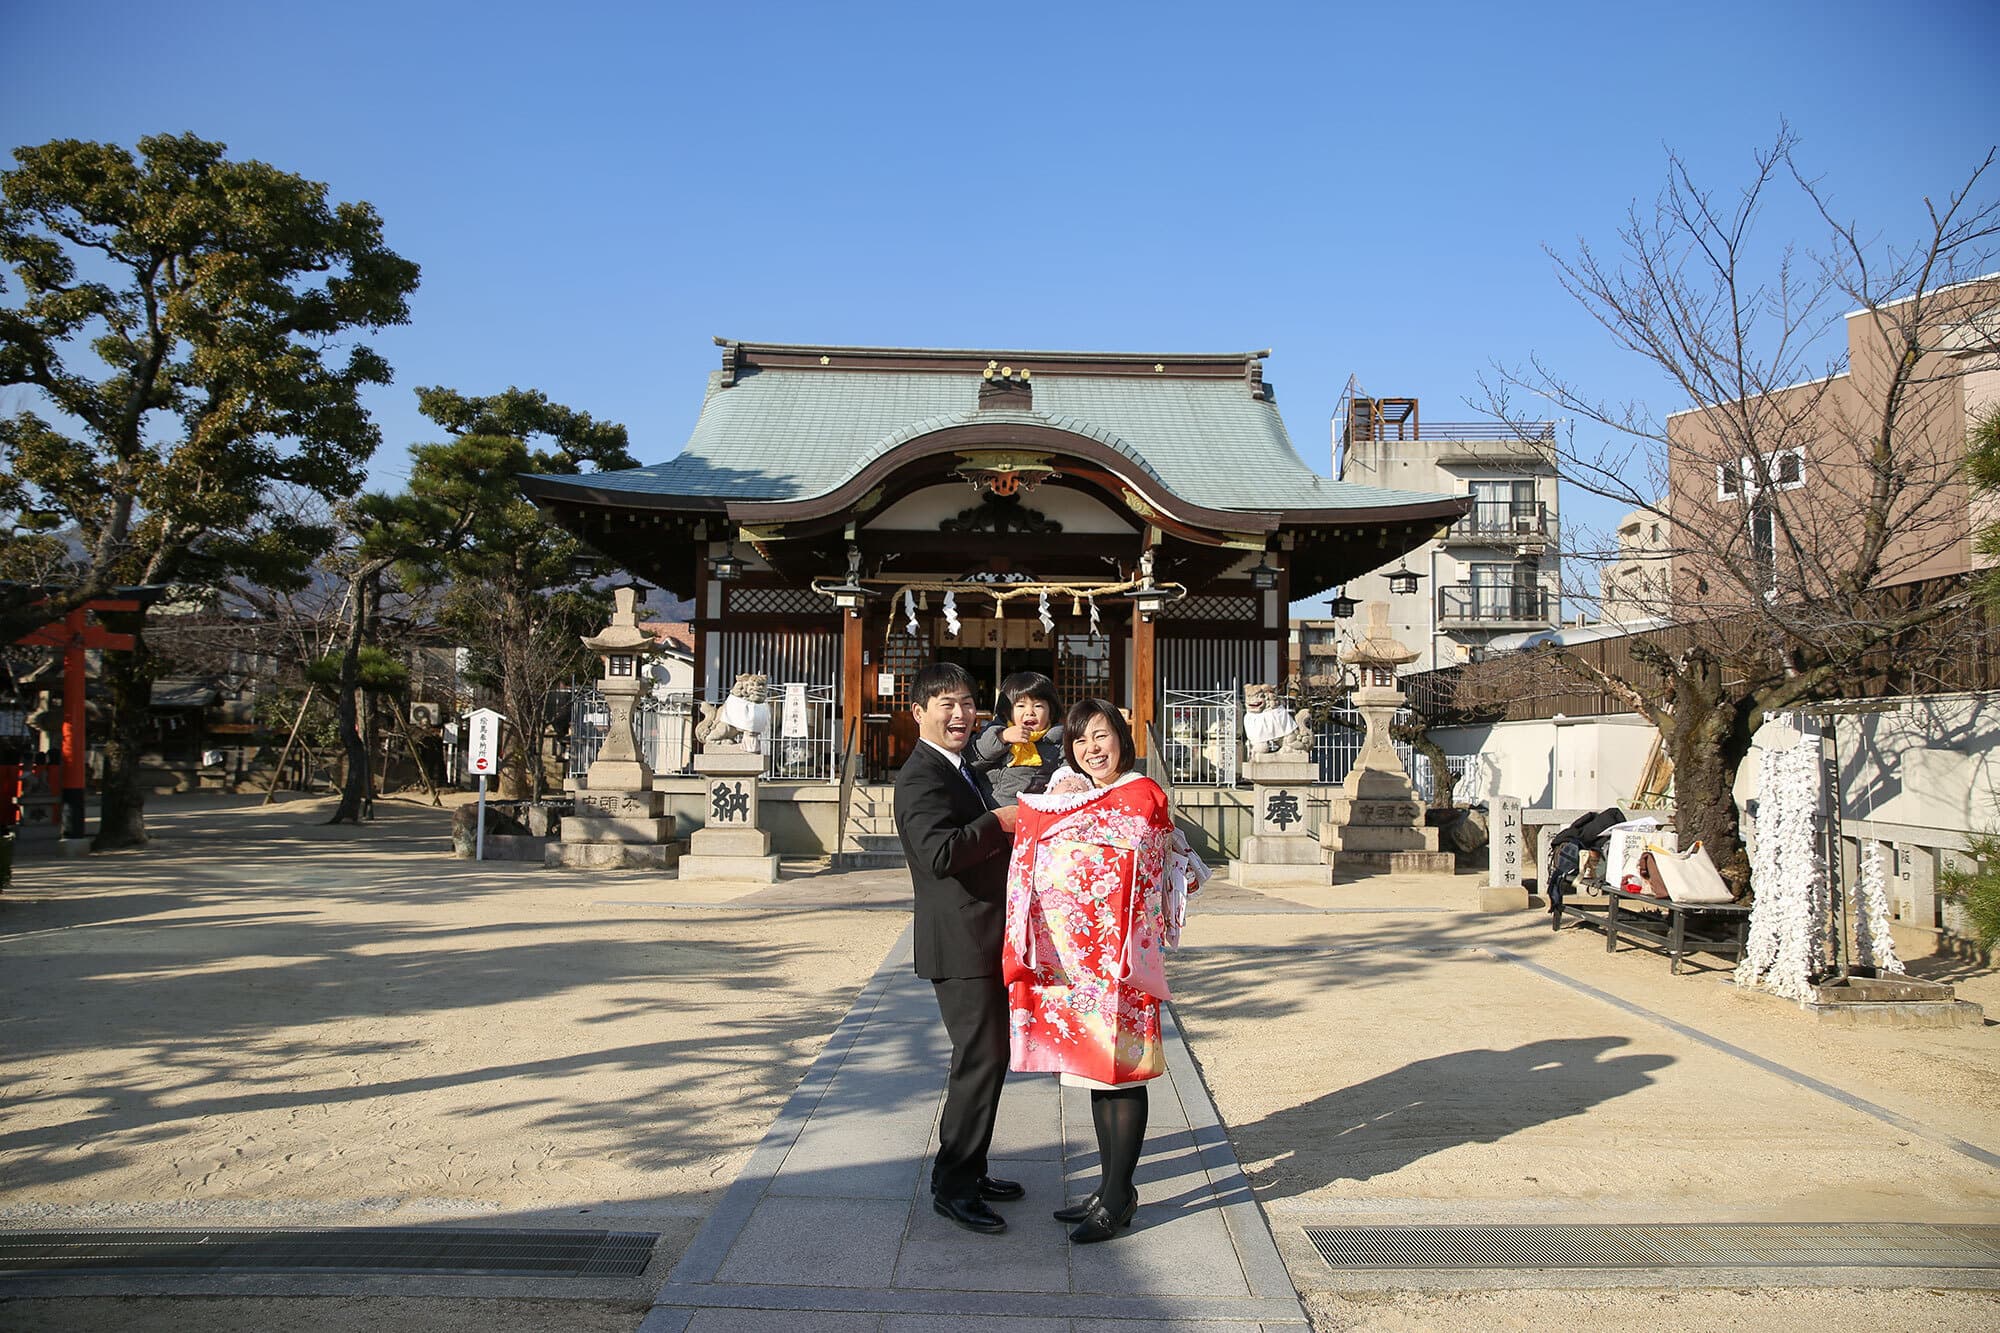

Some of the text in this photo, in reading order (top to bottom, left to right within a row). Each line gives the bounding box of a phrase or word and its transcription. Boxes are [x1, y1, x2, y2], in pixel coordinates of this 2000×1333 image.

[712, 781, 750, 822] 納
[1264, 790, 1303, 831] 奉
[1504, 814, 1516, 883] 山本昌和
